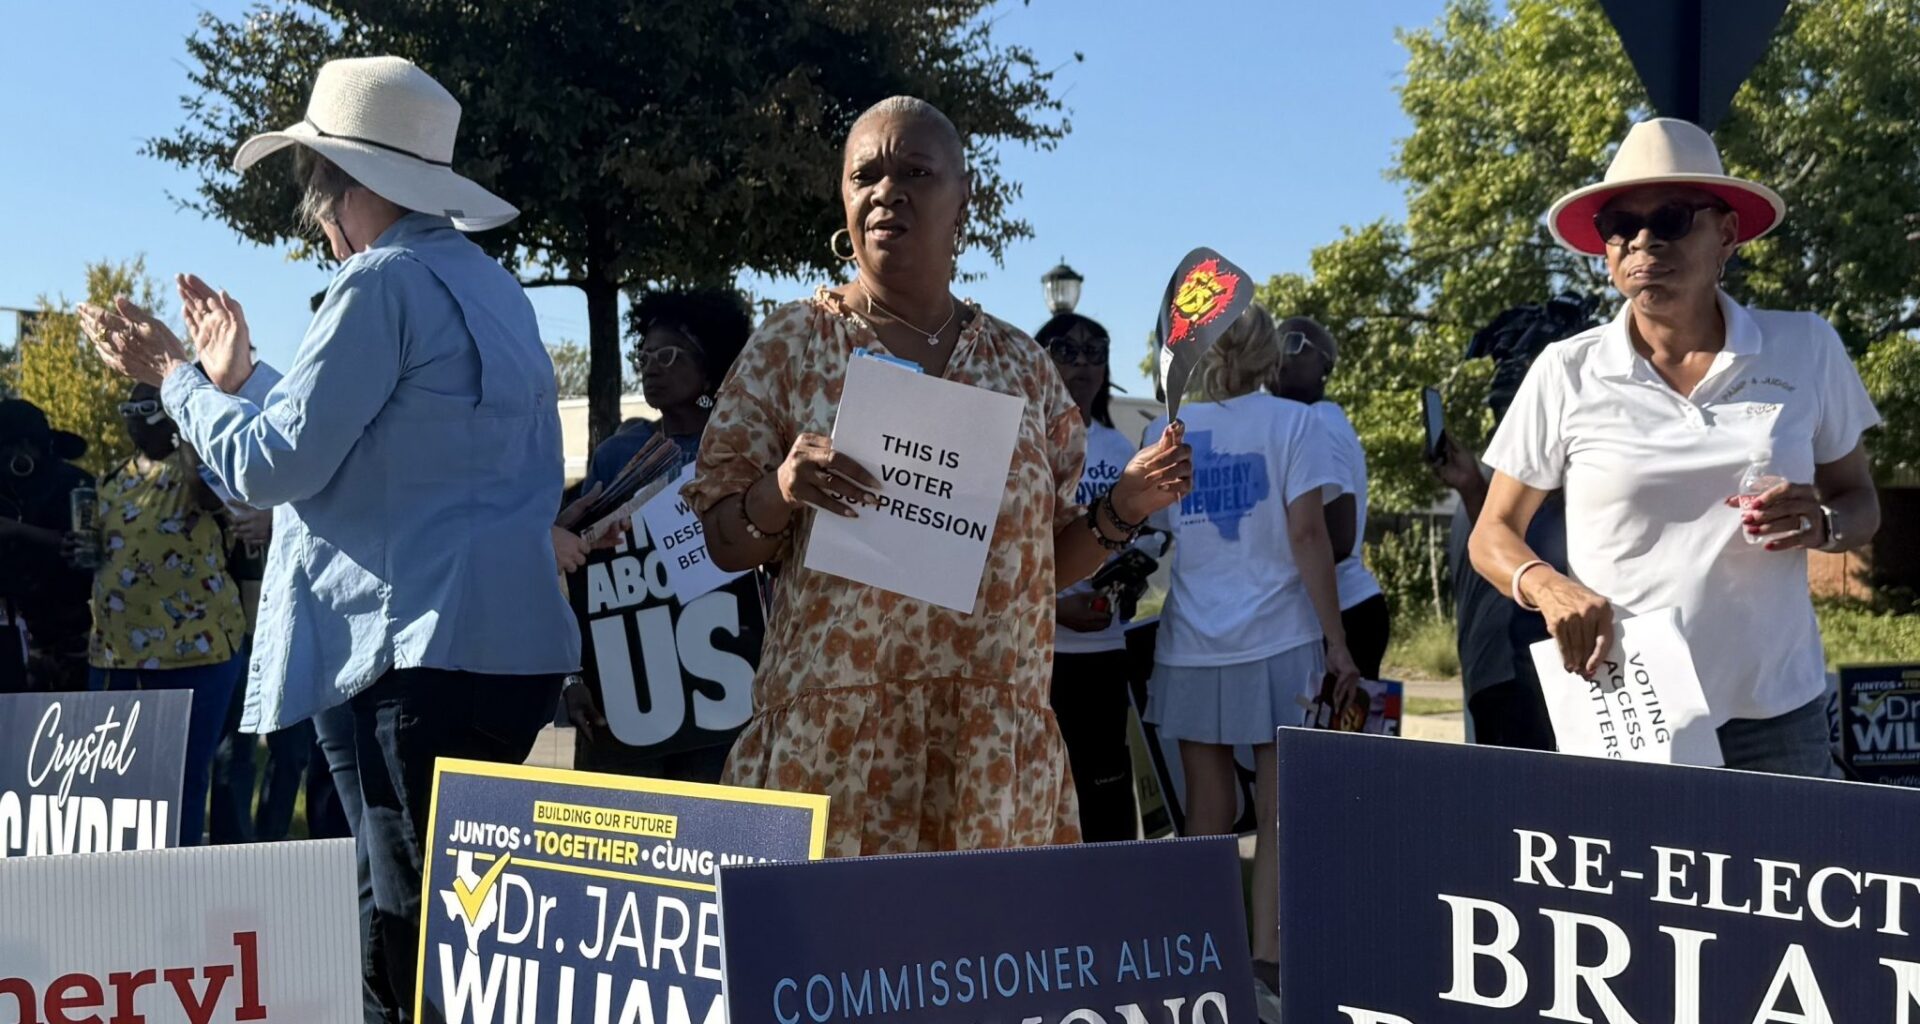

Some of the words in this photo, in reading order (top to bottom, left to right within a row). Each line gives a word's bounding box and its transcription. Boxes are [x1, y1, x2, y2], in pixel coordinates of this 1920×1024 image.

[881, 464, 953, 499] VOTER
[882, 434, 932, 462] THIS
[939, 450, 960, 469] IS
[1080, 459, 1120, 479] ote
[831, 491, 987, 542] PRESSION
[590, 590, 755, 747] US
[1603, 660, 1646, 751] ACCESS
[1629, 652, 1670, 744] VOTING
[27, 700, 141, 807] Crystal
[449, 820, 521, 850] JUNTOS
[534, 829, 639, 866] TOGETHER
[652, 840, 714, 876] CÙNG
[538, 805, 592, 824] BUILDING
[595, 812, 621, 829] OUR
[624, 816, 673, 834] FUTURE
[497, 873, 565, 953] Dr.
[1513, 828, 1920, 936] RE-ELECT
[774, 945, 1099, 1024] COMMISSIONER
[1117, 932, 1222, 983] ALISA
